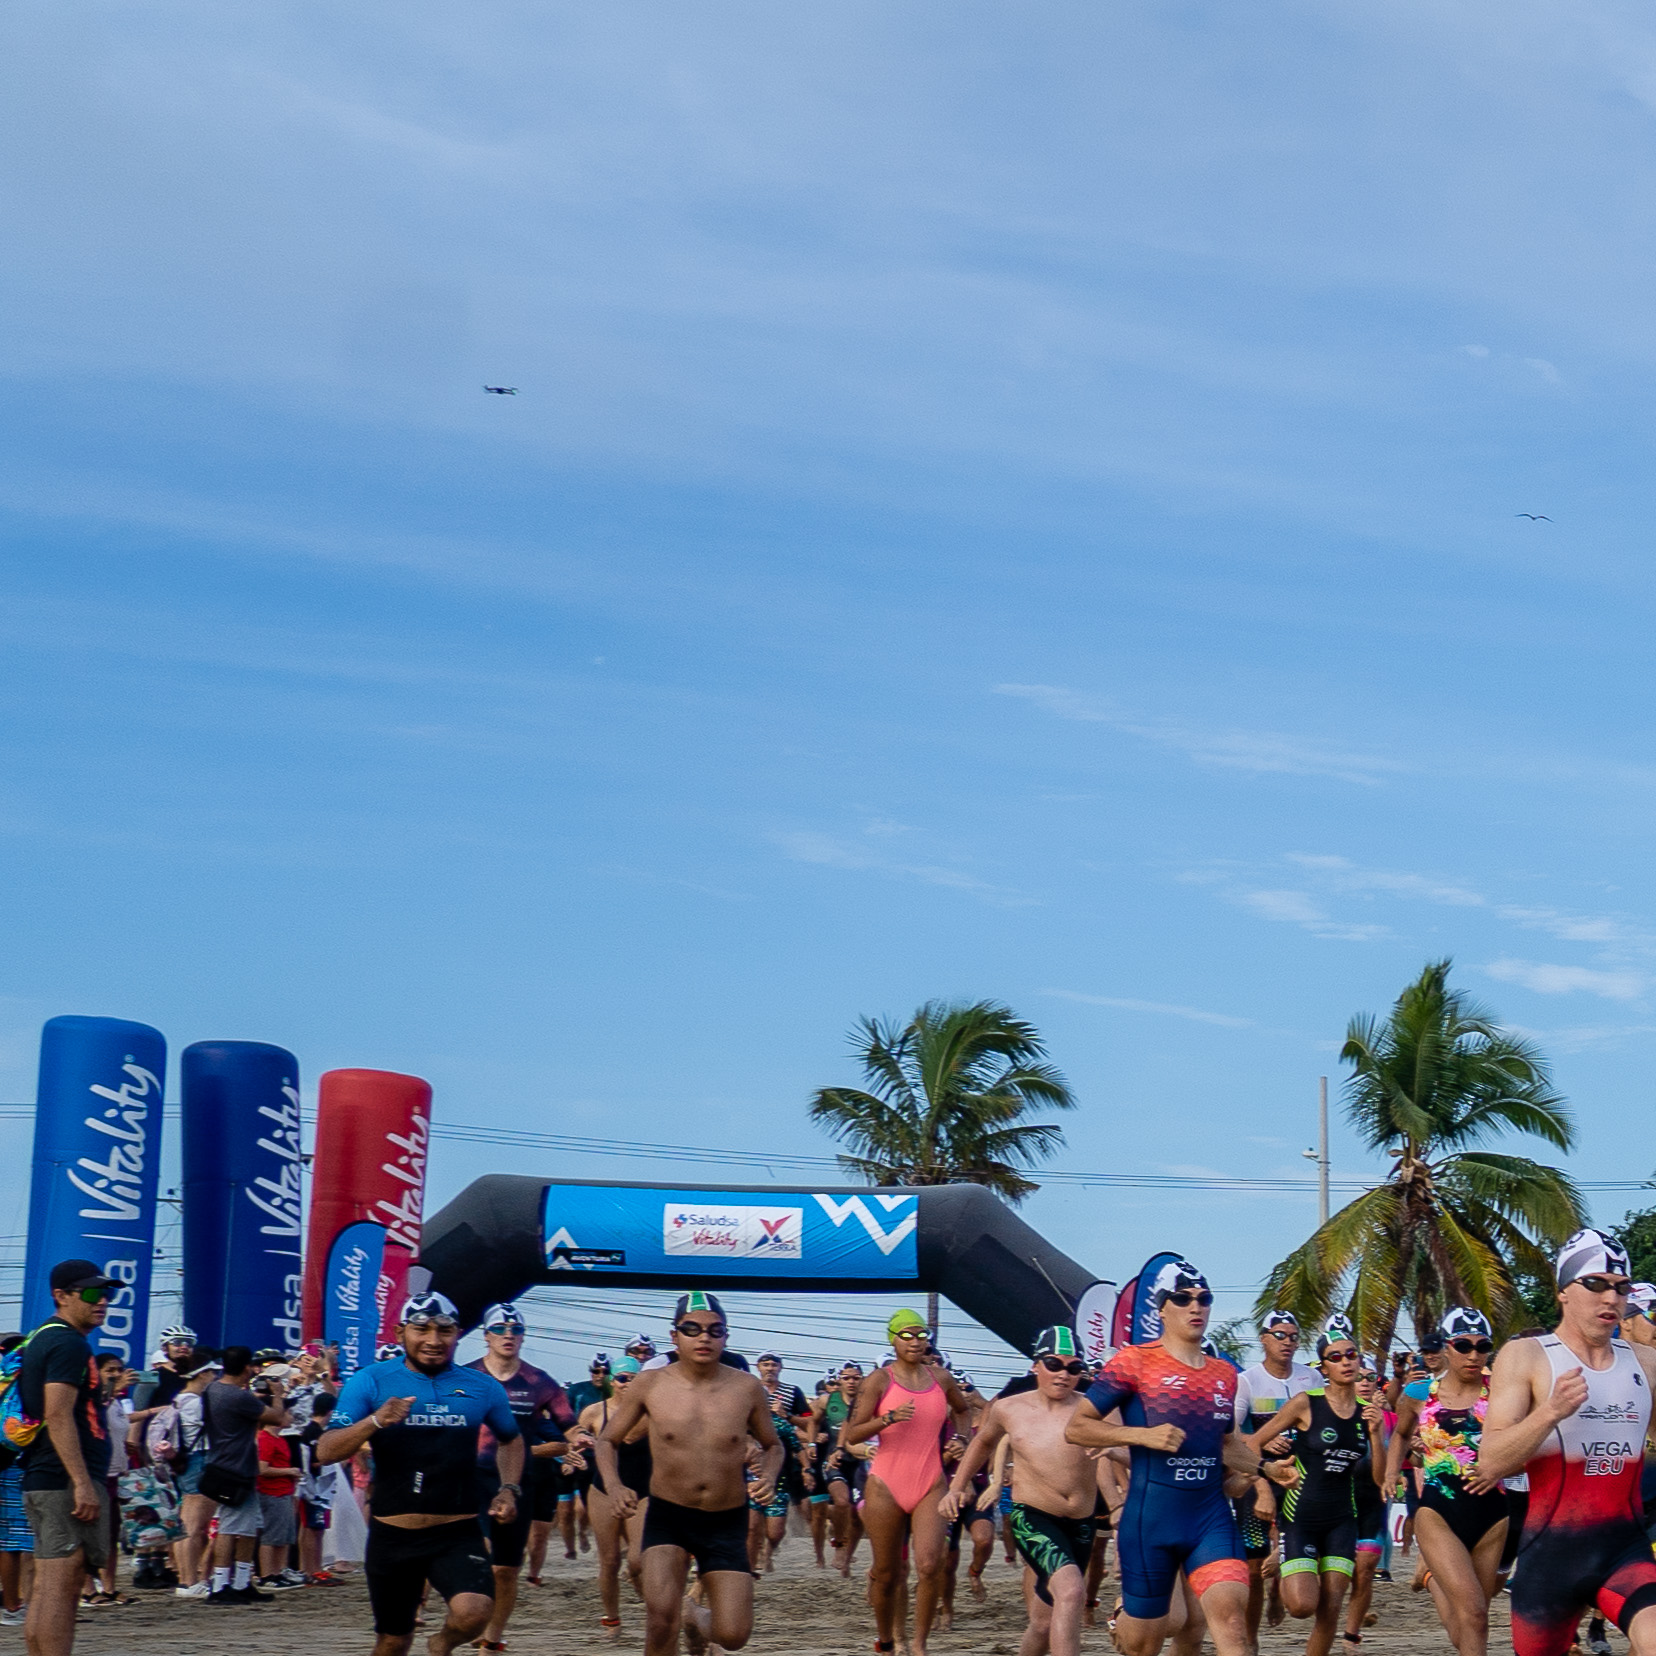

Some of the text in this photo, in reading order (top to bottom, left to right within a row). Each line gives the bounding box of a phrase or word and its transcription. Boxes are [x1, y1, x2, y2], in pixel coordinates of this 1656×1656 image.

[244, 1086, 299, 1237] Vitality
[66, 1061, 162, 1364] udsa Vitality
[688, 1214, 740, 1227] Saludsa
[691, 1228, 740, 1252] Vitality
[338, 1245, 368, 1312] Vitality
[424, 1403, 449, 1414] TEAM
[1581, 1441, 1633, 1457] VEGA
[1166, 1456, 1217, 1467] ORDOÑEZ
[1583, 1457, 1625, 1477] ECU
[1174, 1468, 1208, 1481] ECU
